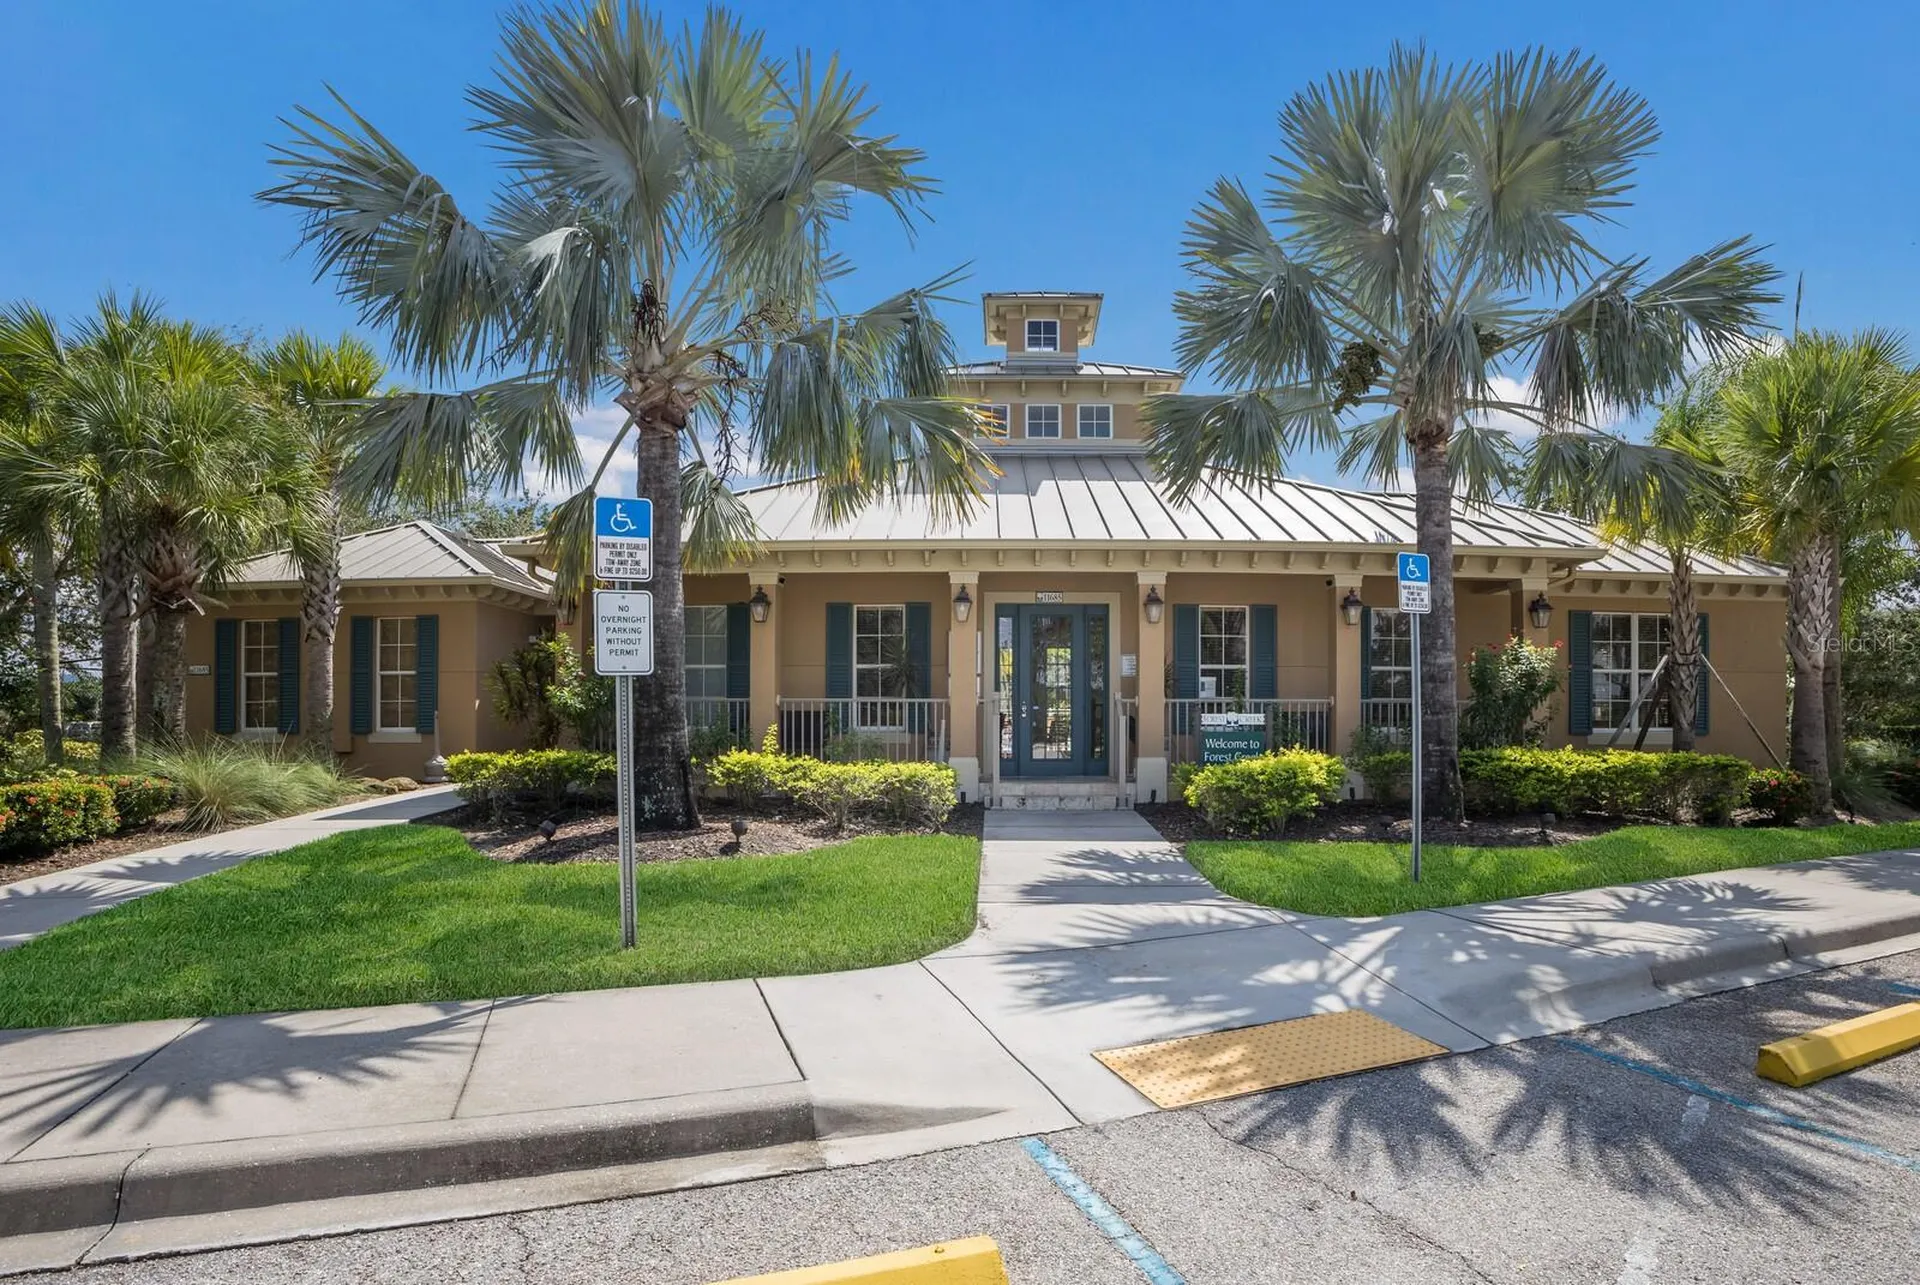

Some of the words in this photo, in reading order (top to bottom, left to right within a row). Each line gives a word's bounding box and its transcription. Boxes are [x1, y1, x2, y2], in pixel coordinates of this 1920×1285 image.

[600, 541, 618, 549] PARKING
[619, 542, 625, 550] BY
[626, 543, 647, 551] DISABLED
[609, 550, 626, 558] PERMIT
[626, 551, 637, 559] ONLY
[629, 559, 641, 567] ZONE
[604, 566, 614, 574] FINE
[615, 567, 621, 575] UP
[622, 567, 628, 575] TO
[618, 604, 630, 612] NO
[600, 615, 647, 623] OVERNIGHT
[605, 626, 642, 634] PARKING
[605, 637, 641, 646] WITHOUT
[608, 648, 639, 657] PERMIT
[1205, 738, 1248, 749] Welcome
[1249, 739, 1260, 749] to
[1204, 751, 1232, 762] Forest
